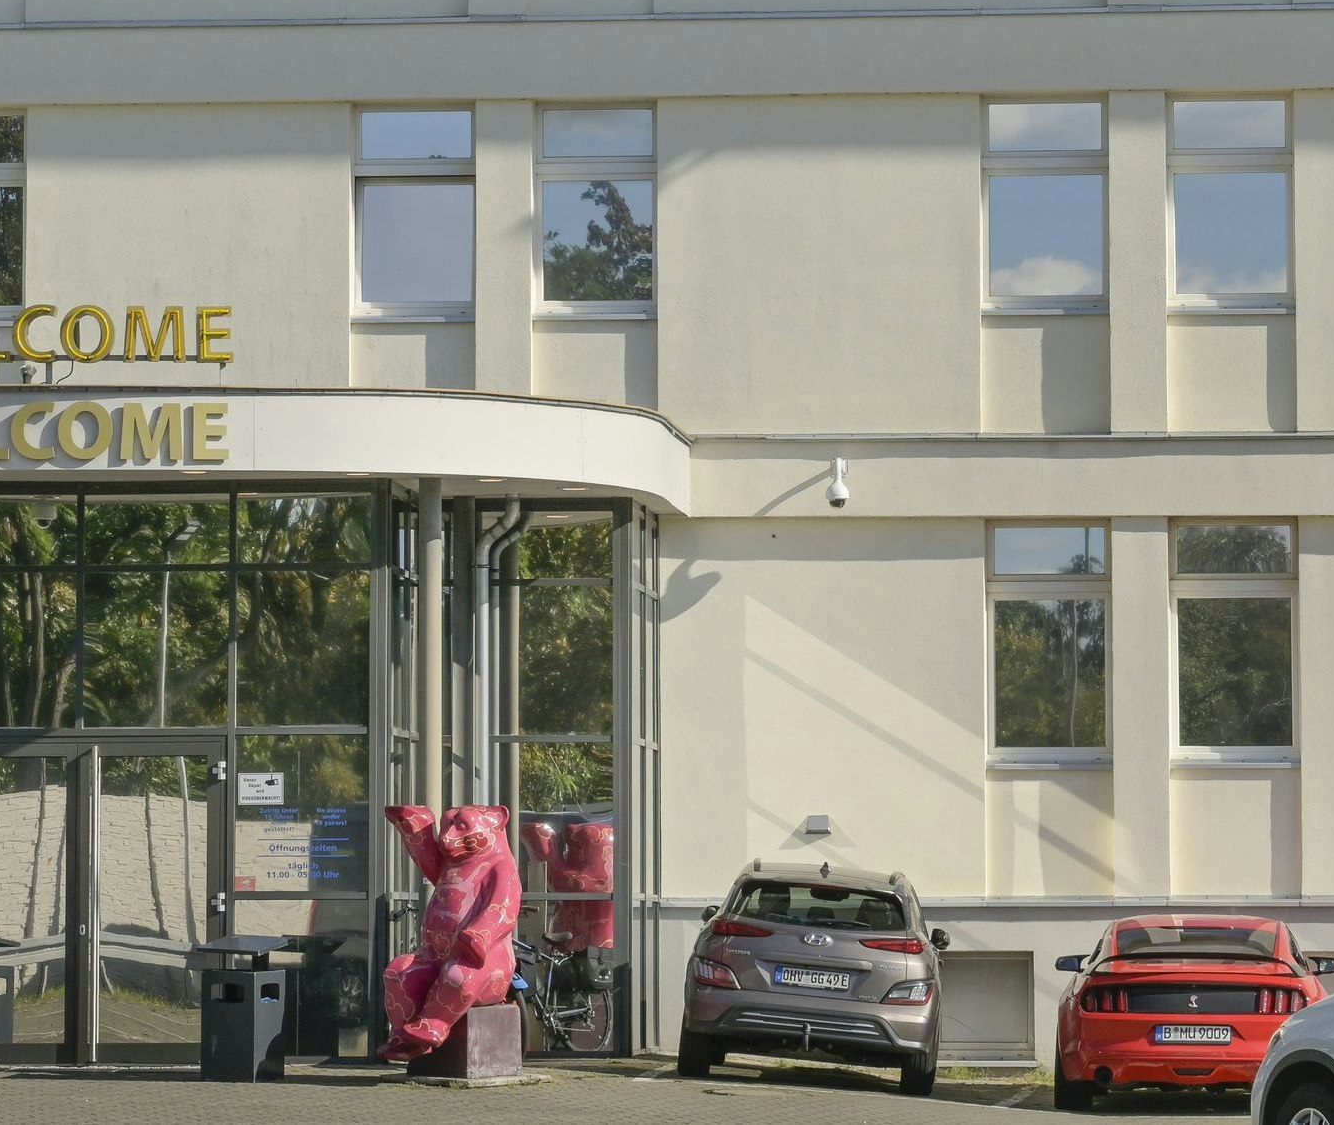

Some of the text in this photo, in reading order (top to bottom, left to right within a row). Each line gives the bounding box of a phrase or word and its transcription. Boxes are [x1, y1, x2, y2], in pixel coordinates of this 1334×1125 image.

[269, 843, 338, 853] Öffnungszeiten
[323, 870, 340, 878] Uhr
[783, 969, 804, 982] OHV
[811, 972, 825, 984] GG
[1164, 1027, 1229, 1039] B MU 9009
